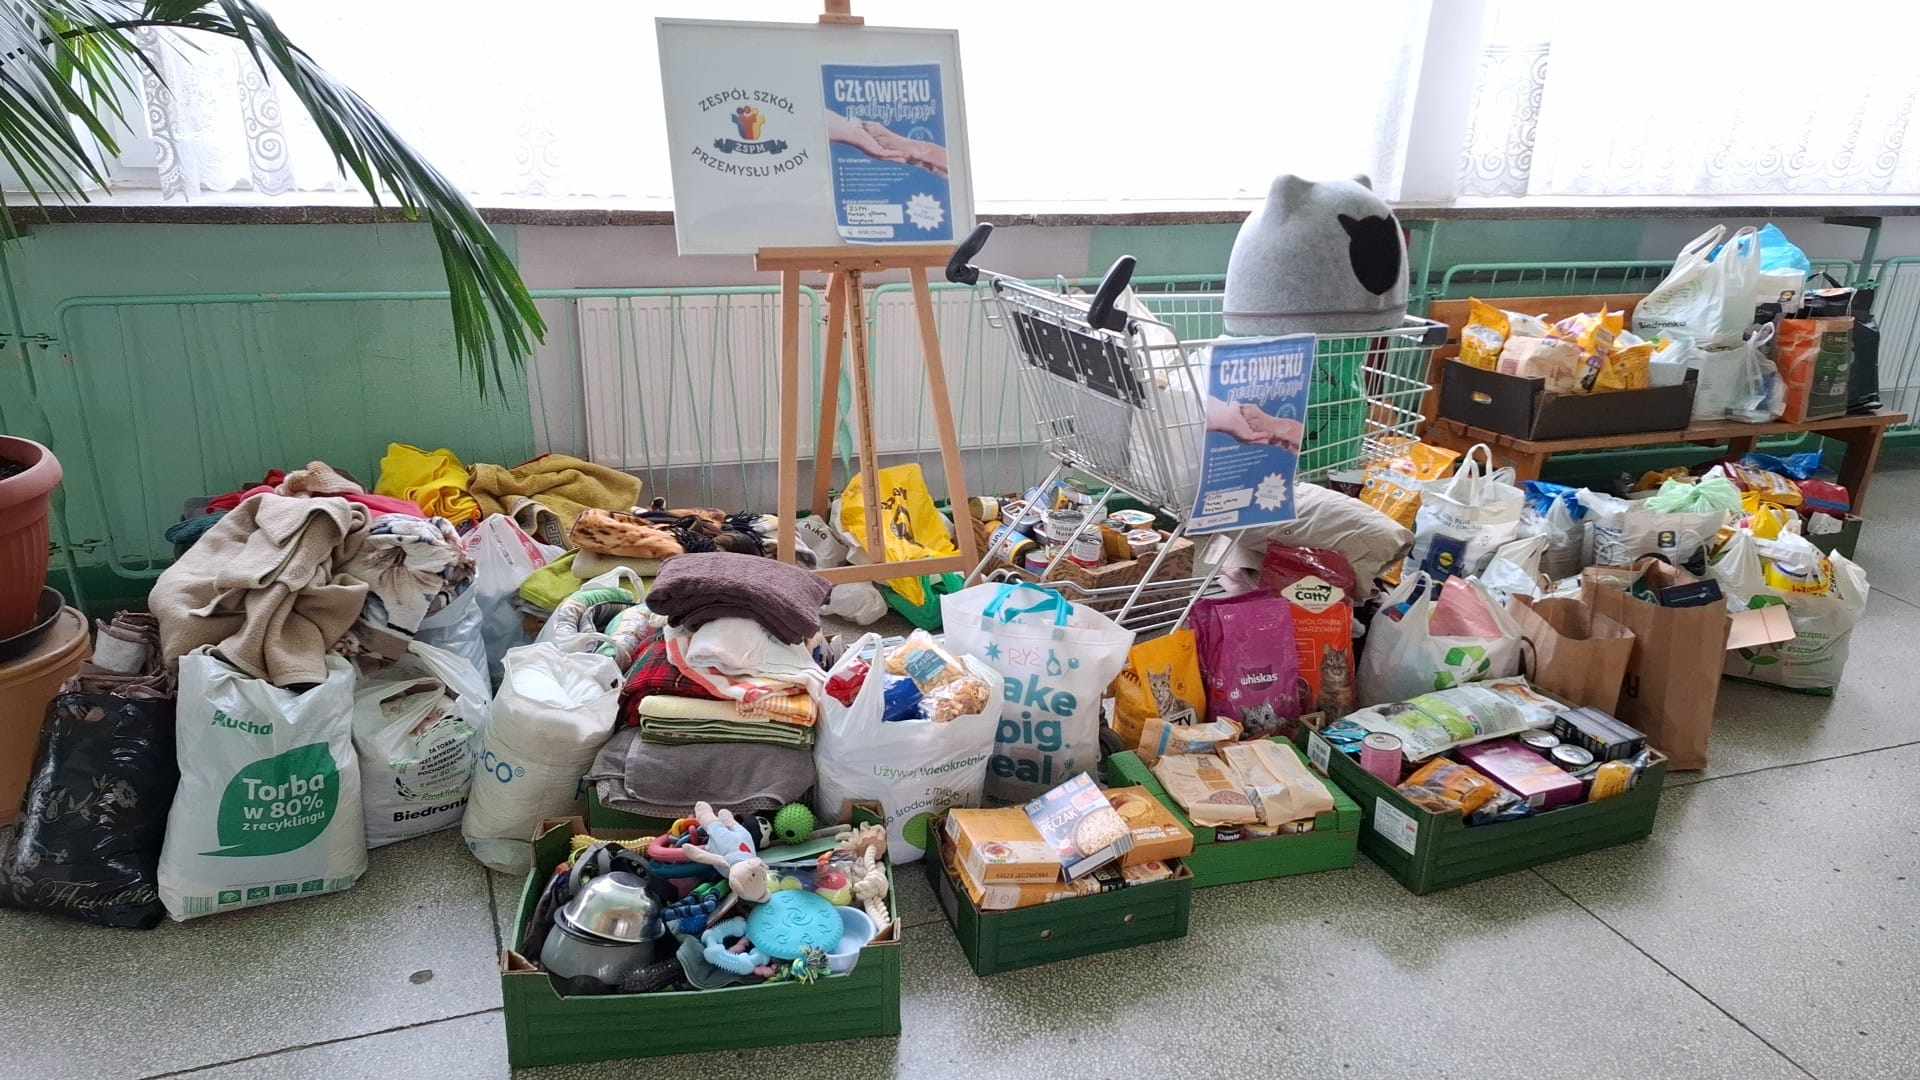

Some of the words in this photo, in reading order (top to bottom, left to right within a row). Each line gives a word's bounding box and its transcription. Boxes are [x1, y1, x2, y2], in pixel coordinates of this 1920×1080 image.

[698, 88, 750, 112] ZESPÓŁ
[753, 90, 795, 114] SZKÓŁ
[834, 79, 930, 102] CZŁOWIEKU
[735, 142, 766, 154] ZSPM
[691, 146, 770, 177] PRZEMYSŁU
[773, 148, 809, 175] MODY
[1219, 353, 1304, 385] CZŁOWIEKU
[1295, 590, 1331, 602] Catty
[1240, 672, 1278, 686] whiskas
[1003, 673, 1077, 717] ake
[211, 710, 274, 735] Aucha
[991, 754, 1052, 785] eal
[241, 774, 325, 801] Torba
[243, 806, 264, 820] w
[270, 793, 324, 819] 80%
[393, 797, 470, 822] Biedronk
[242, 822, 250, 831] z
[252, 811, 325, 832] recyklingu
